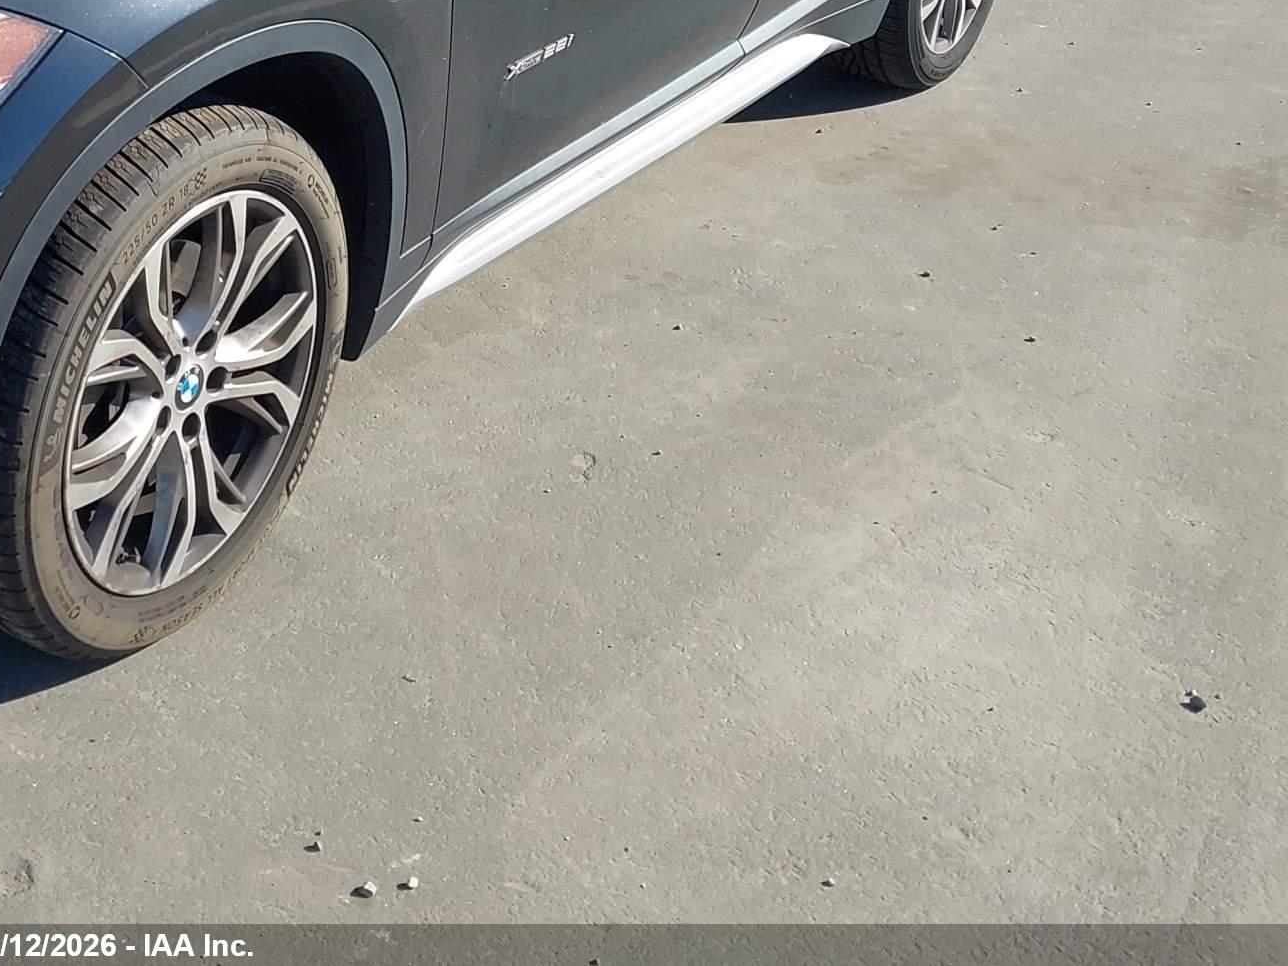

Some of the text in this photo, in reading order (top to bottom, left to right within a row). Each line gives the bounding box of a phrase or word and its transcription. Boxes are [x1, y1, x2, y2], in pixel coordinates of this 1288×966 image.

[122, 213, 159, 265] 225/50
[161, 196, 176, 216] ZR
[52, 279, 114, 425] MICHELIN
